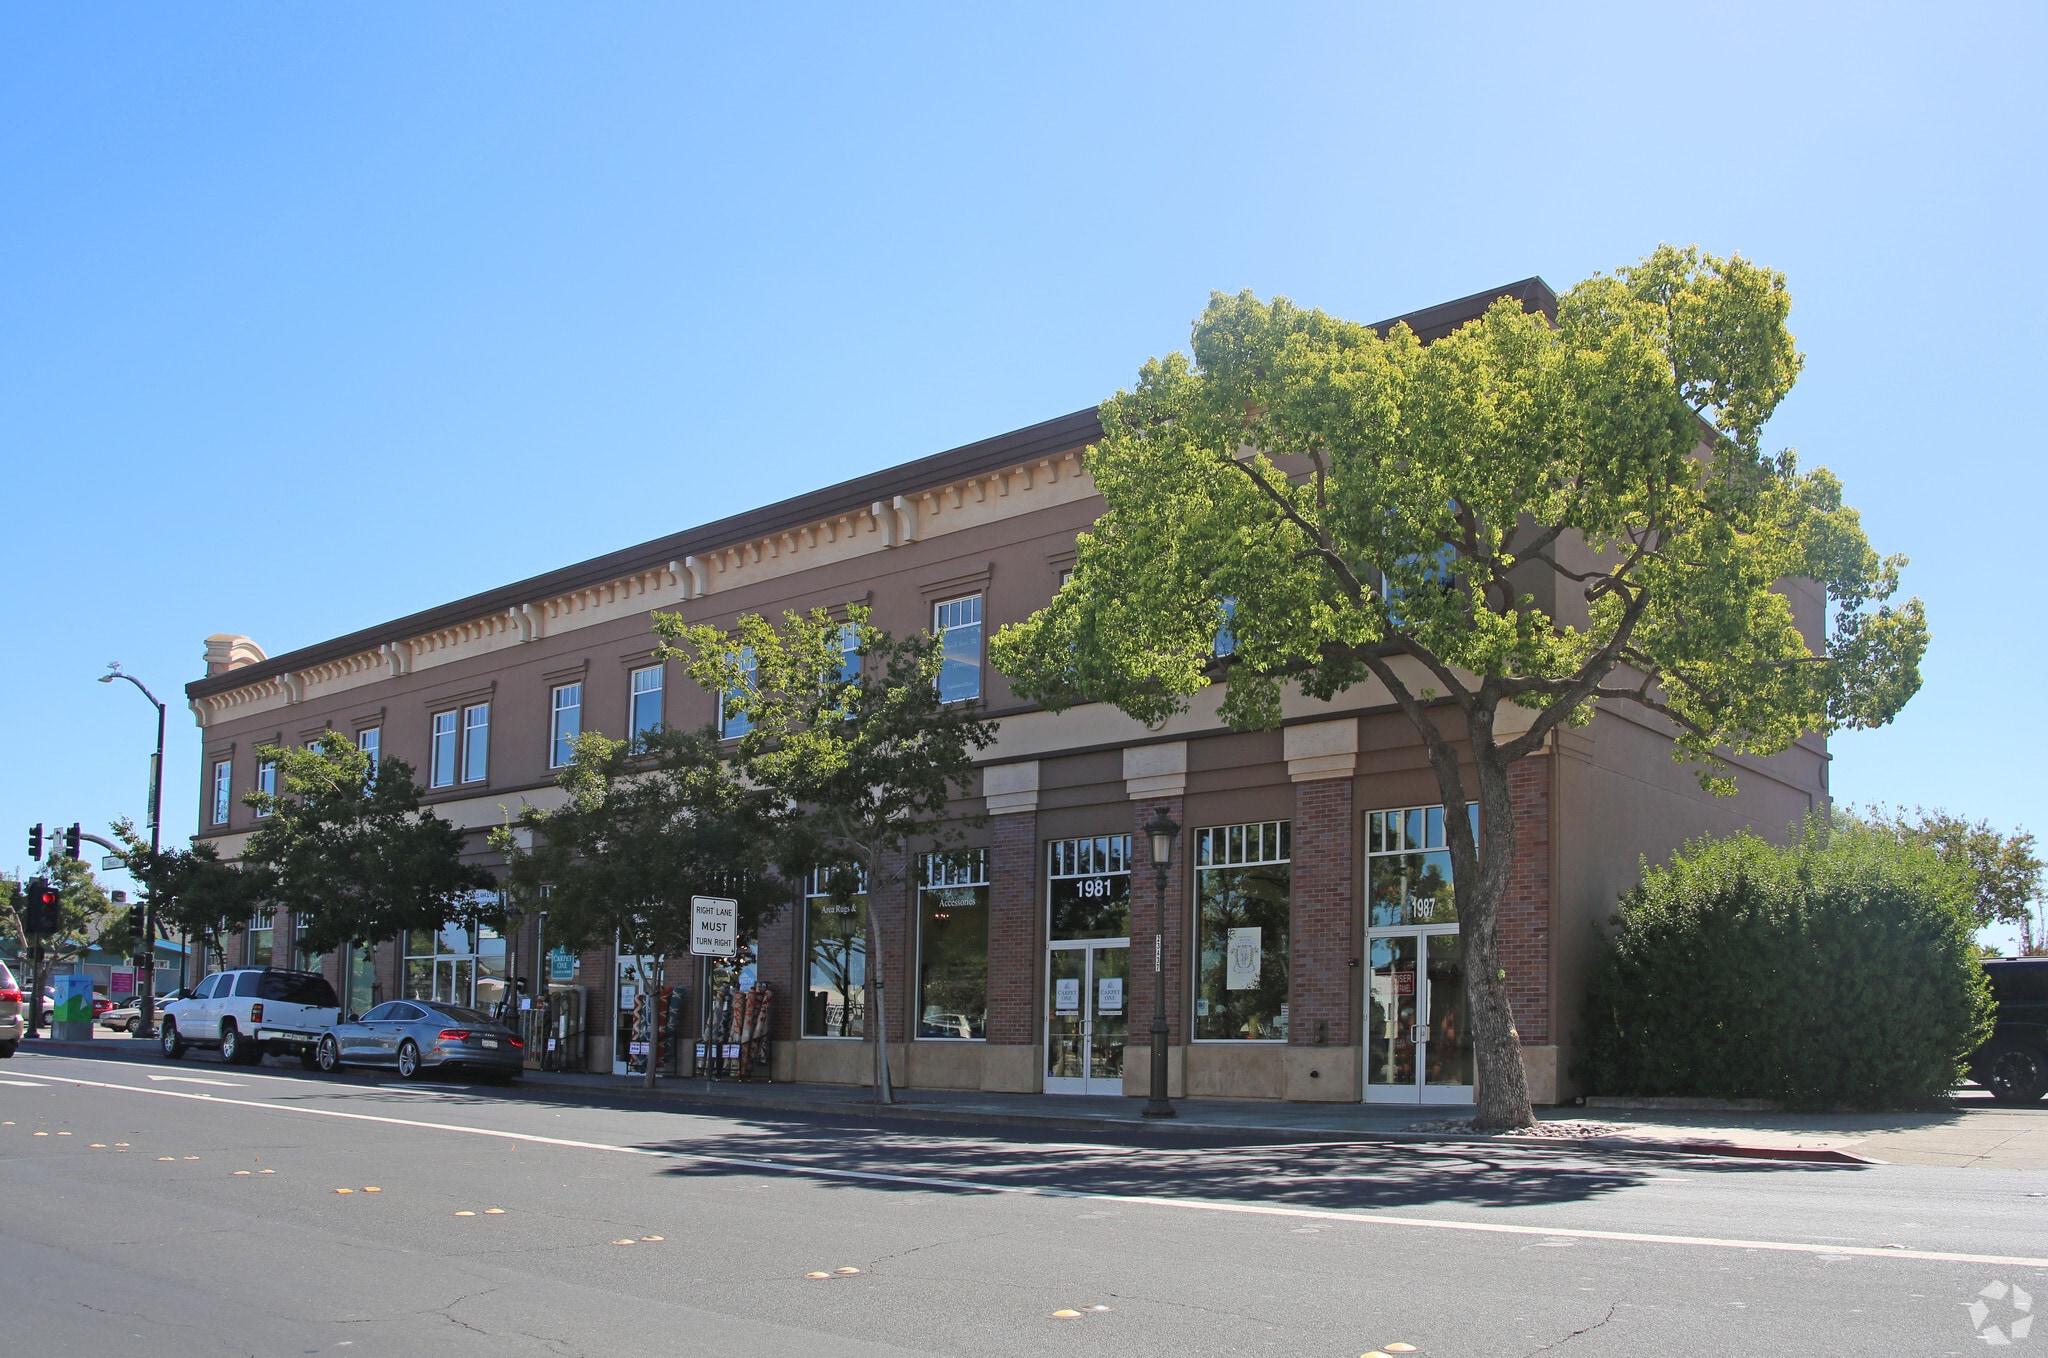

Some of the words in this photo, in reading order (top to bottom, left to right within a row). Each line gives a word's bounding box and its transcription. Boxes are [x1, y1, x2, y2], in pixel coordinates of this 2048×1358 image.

[1076, 879, 1111, 898] 1981
[939, 898, 976, 907] Accessories
[1411, 897, 1436, 918] 1987
[696, 906, 714, 915] RIGHT
[716, 908, 733, 917] LANE
[821, 906, 834, 914] Area
[836, 904, 850, 915] Rugs
[851, 903, 857, 912] &
[701, 921, 727, 932] MUST
[696, 936, 713, 946] TURN
[714, 938, 732, 948] RIGHT
[553, 954, 572, 962] CARPET
